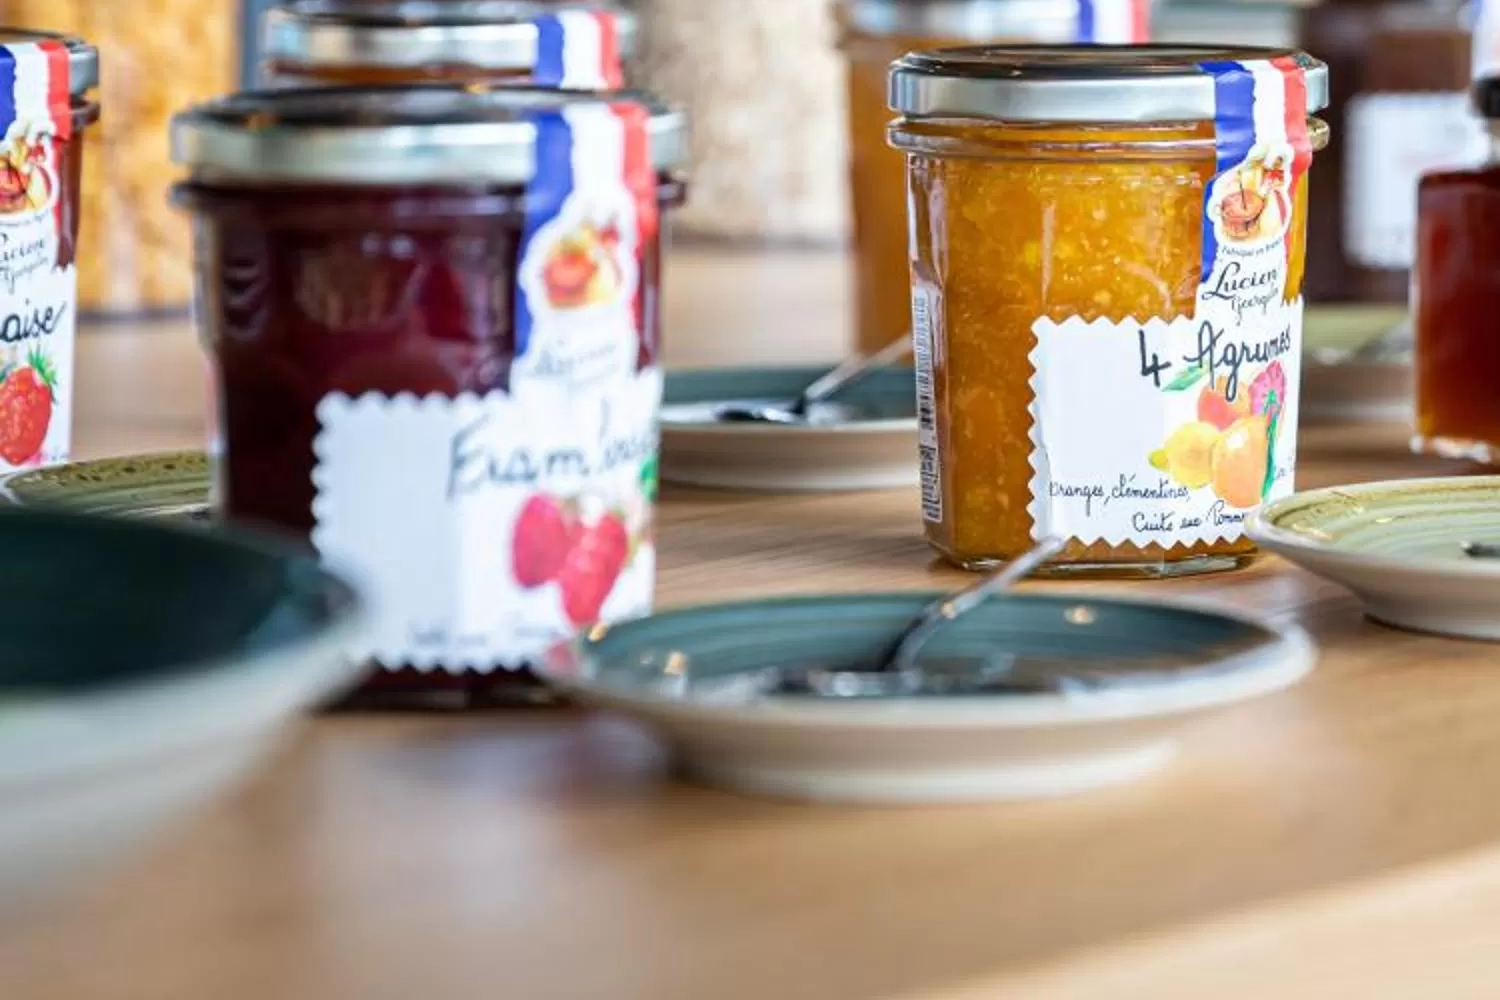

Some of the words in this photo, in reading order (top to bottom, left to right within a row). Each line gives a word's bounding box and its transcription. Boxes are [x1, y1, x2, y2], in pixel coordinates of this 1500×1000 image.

[1201, 260, 1278, 301] Lucien
[0, 300, 67, 344] aise
[1137, 328, 1172, 388] 4
[1182, 319, 1292, 403] Agrumes
